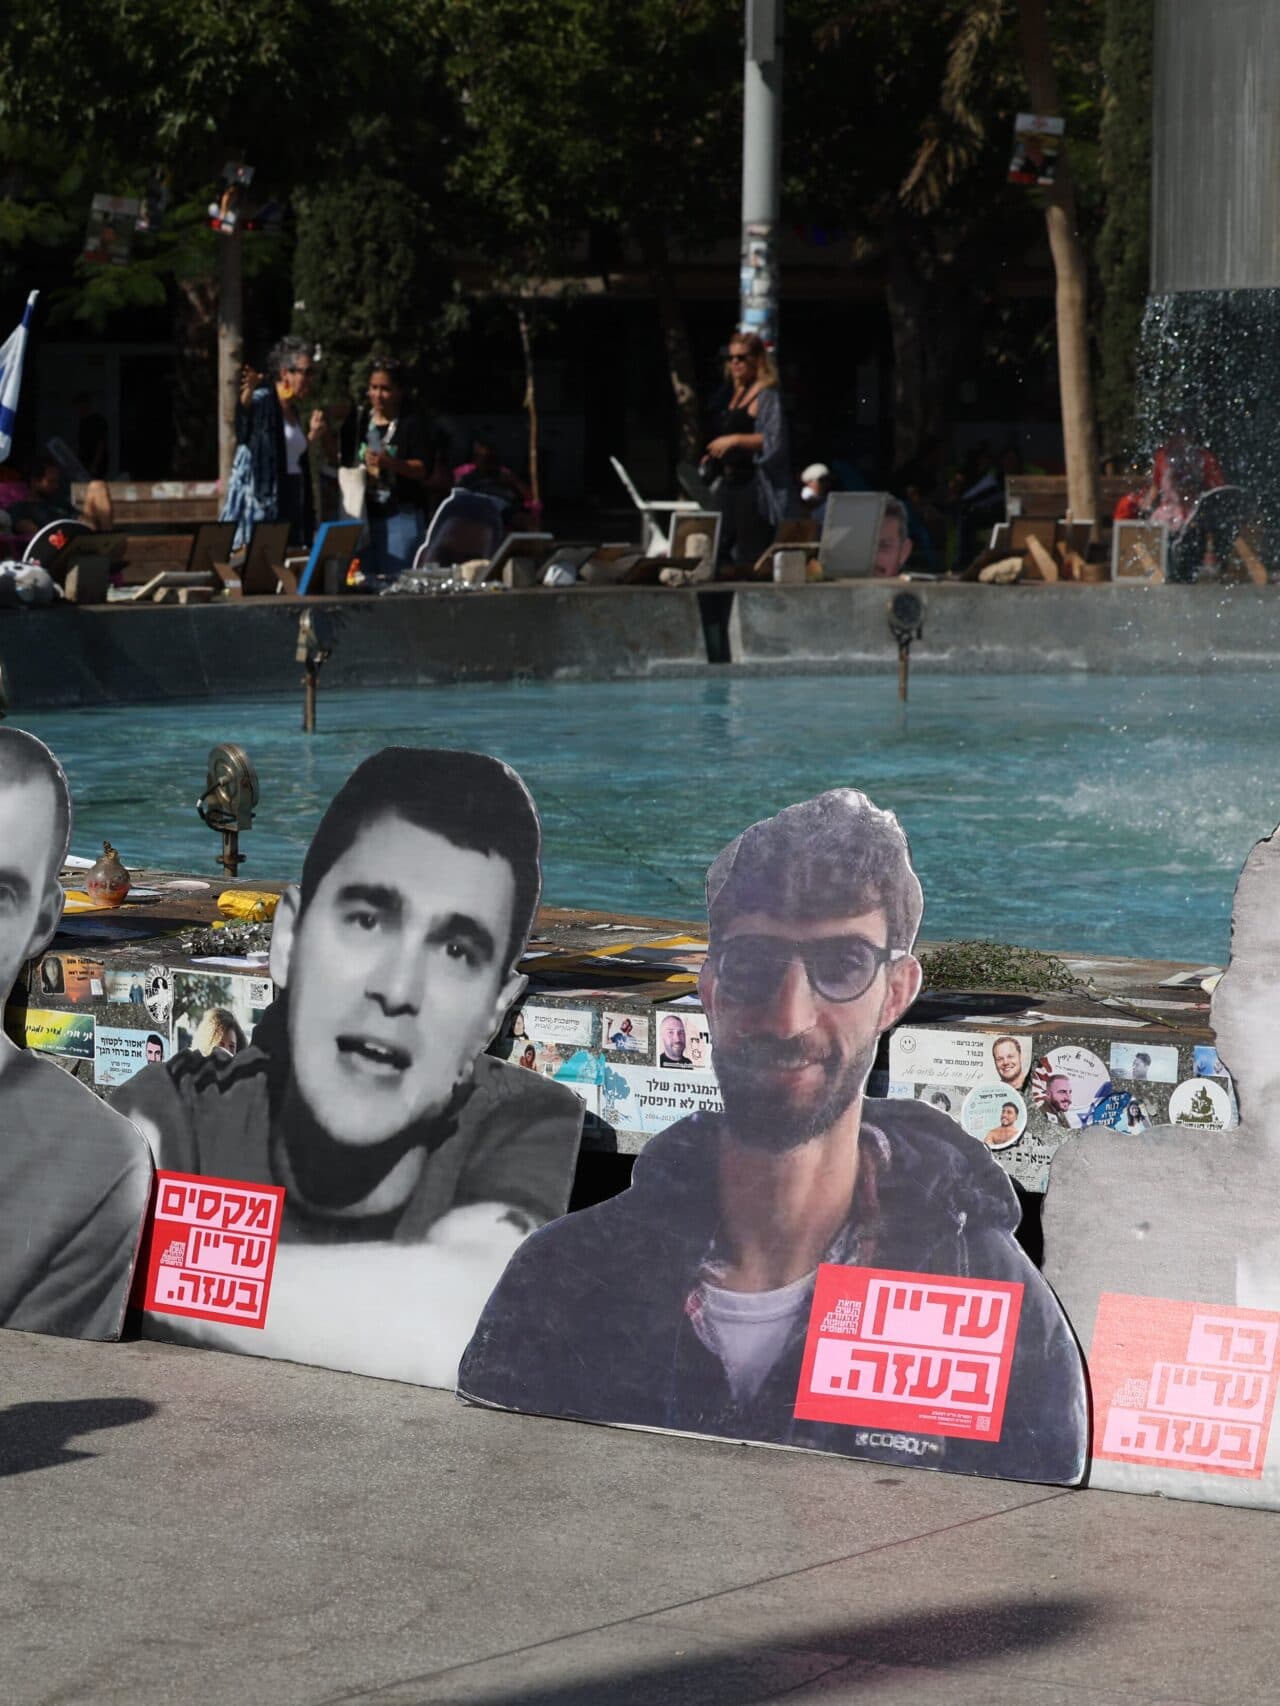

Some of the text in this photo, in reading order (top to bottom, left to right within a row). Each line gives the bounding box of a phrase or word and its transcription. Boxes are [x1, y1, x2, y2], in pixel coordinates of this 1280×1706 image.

[101, 1036, 146, 1048] "אסור לקטוף
[112, 1048, 130, 1057] פרחי
[131, 1049, 142, 1058] את
[634, 1092, 676, 1108] תיפסק"
[645, 1078, 670, 1092] שלך
[679, 1096, 694, 1109] לא
[160, 1184, 272, 1229] מקסים
[191, 1231, 266, 1268] עדיין
[167, 1272, 258, 1313] בעזה.
[871, 1286, 1004, 1339] עדיין
[1203, 1323, 1267, 1365] בר
[829, 1348, 991, 1406] בעזה.
[1155, 1366, 1264, 1409] עדיין
[1120, 1415, 1252, 1462] בעזה.
